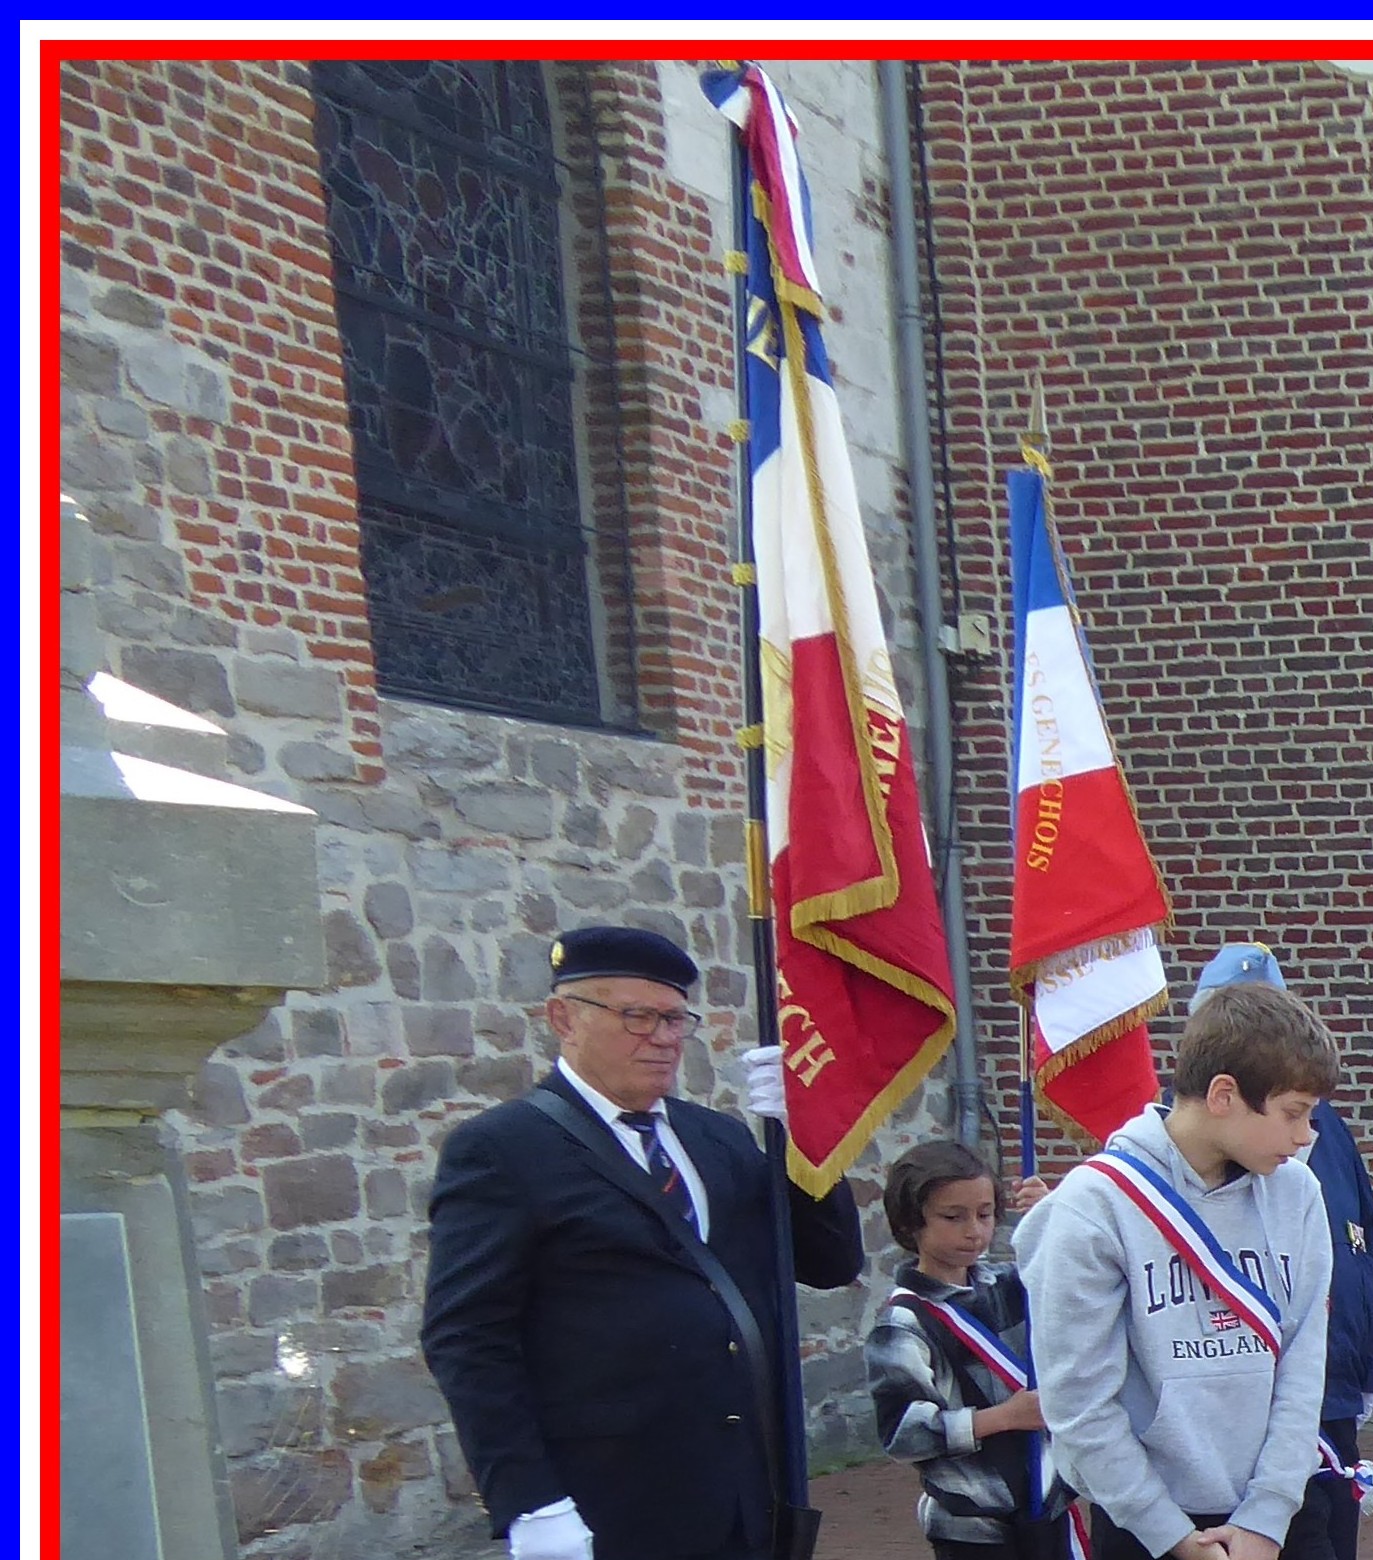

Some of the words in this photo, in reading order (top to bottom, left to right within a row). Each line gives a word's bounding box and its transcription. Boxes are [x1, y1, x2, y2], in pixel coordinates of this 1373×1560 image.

[1026, 694, 1063, 873] GENECHOIS
[1144, 1249, 1292, 1315] LONON
[1172, 1335, 1271, 1359] ENGLAN
